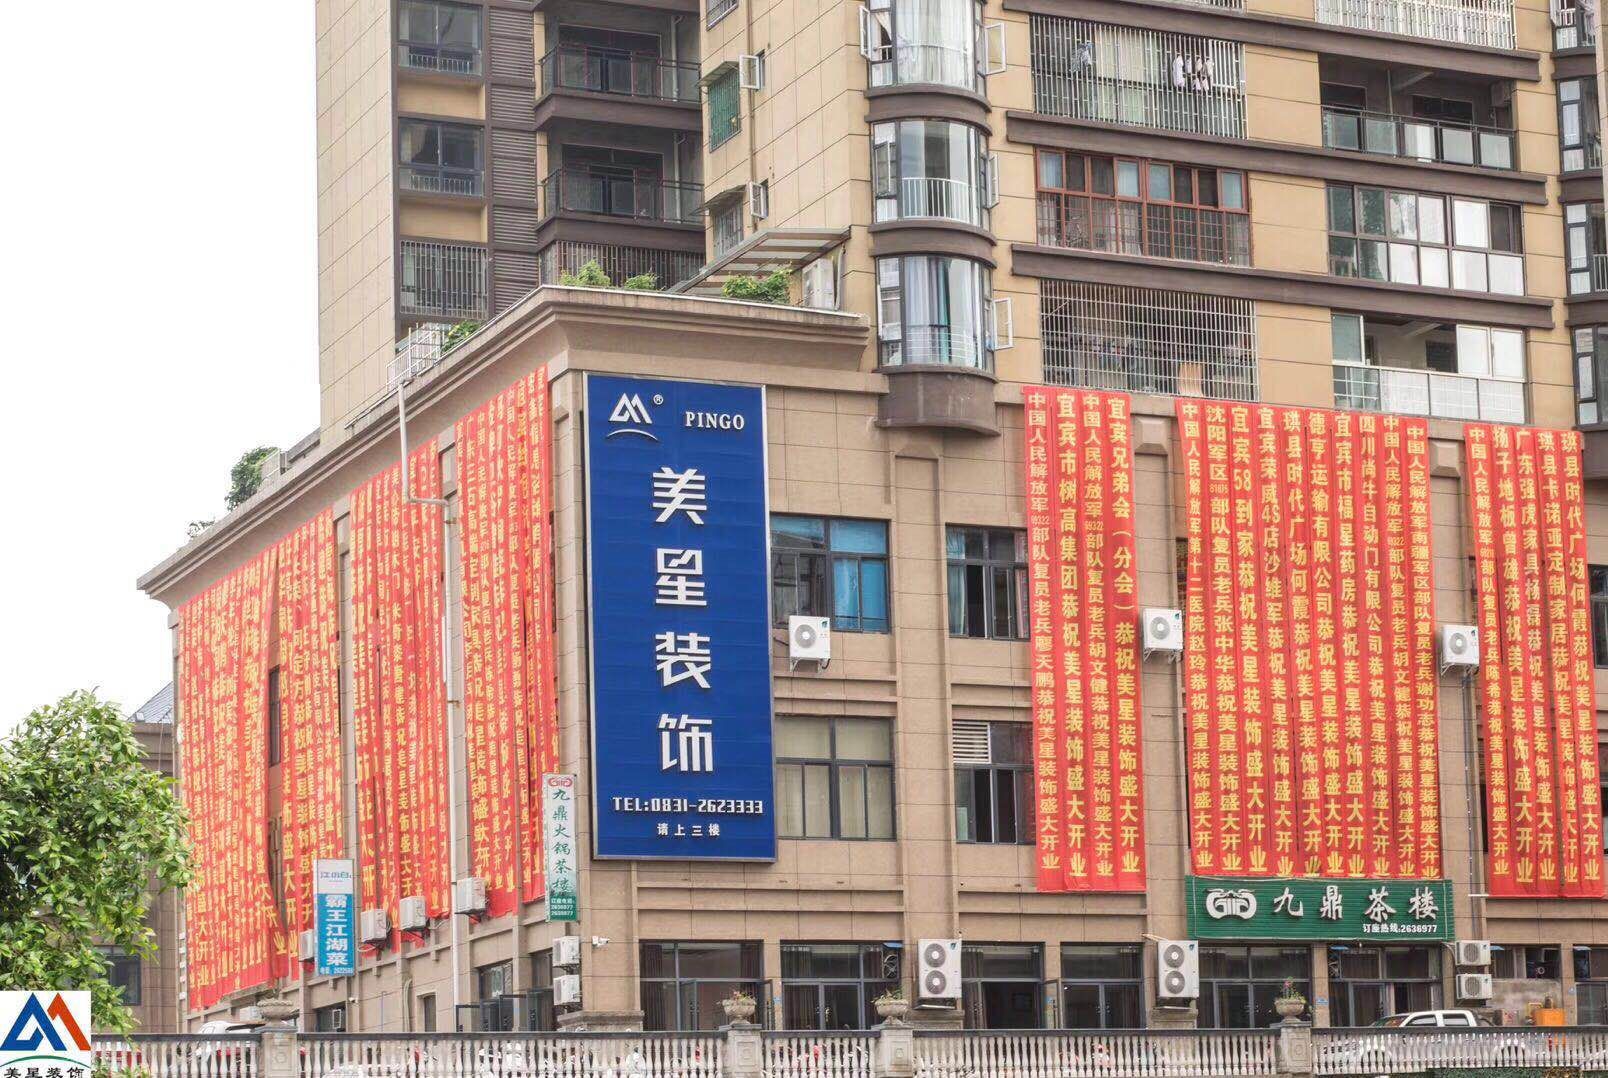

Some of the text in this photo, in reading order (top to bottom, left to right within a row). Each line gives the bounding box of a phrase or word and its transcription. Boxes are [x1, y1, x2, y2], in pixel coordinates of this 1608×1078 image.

[685, 411, 745, 430] PINGO
[652, 466, 714, 772] 美星装饰
[551, 788, 573, 893] 九鼎火锅茶楼
[656, 822, 721, 837] 请上三楼
[1273, 885, 1439, 921] 九鼎茶楼
